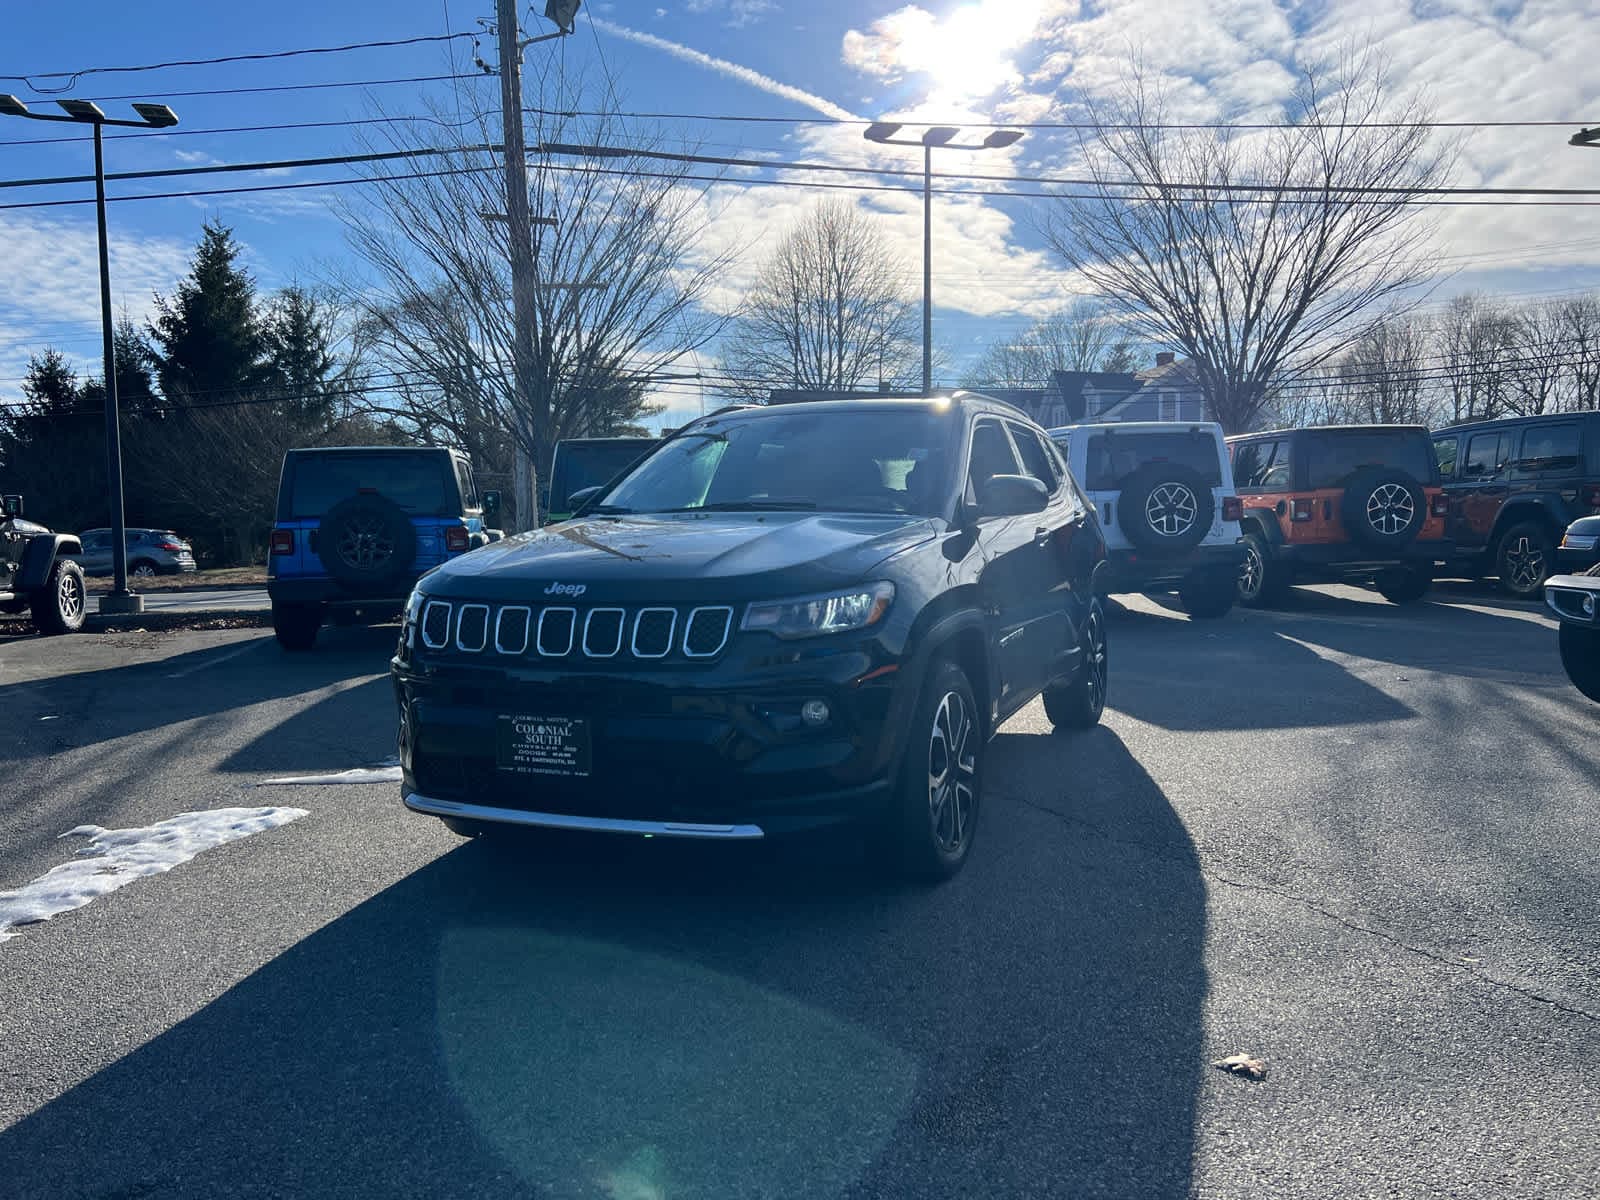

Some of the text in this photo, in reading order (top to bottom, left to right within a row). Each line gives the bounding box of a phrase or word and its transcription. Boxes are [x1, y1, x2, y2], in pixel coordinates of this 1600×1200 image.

[543, 581, 587, 598] Jeep
[515, 723, 572, 737] COLONIAL
[525, 734, 562, 746] SOUTH
